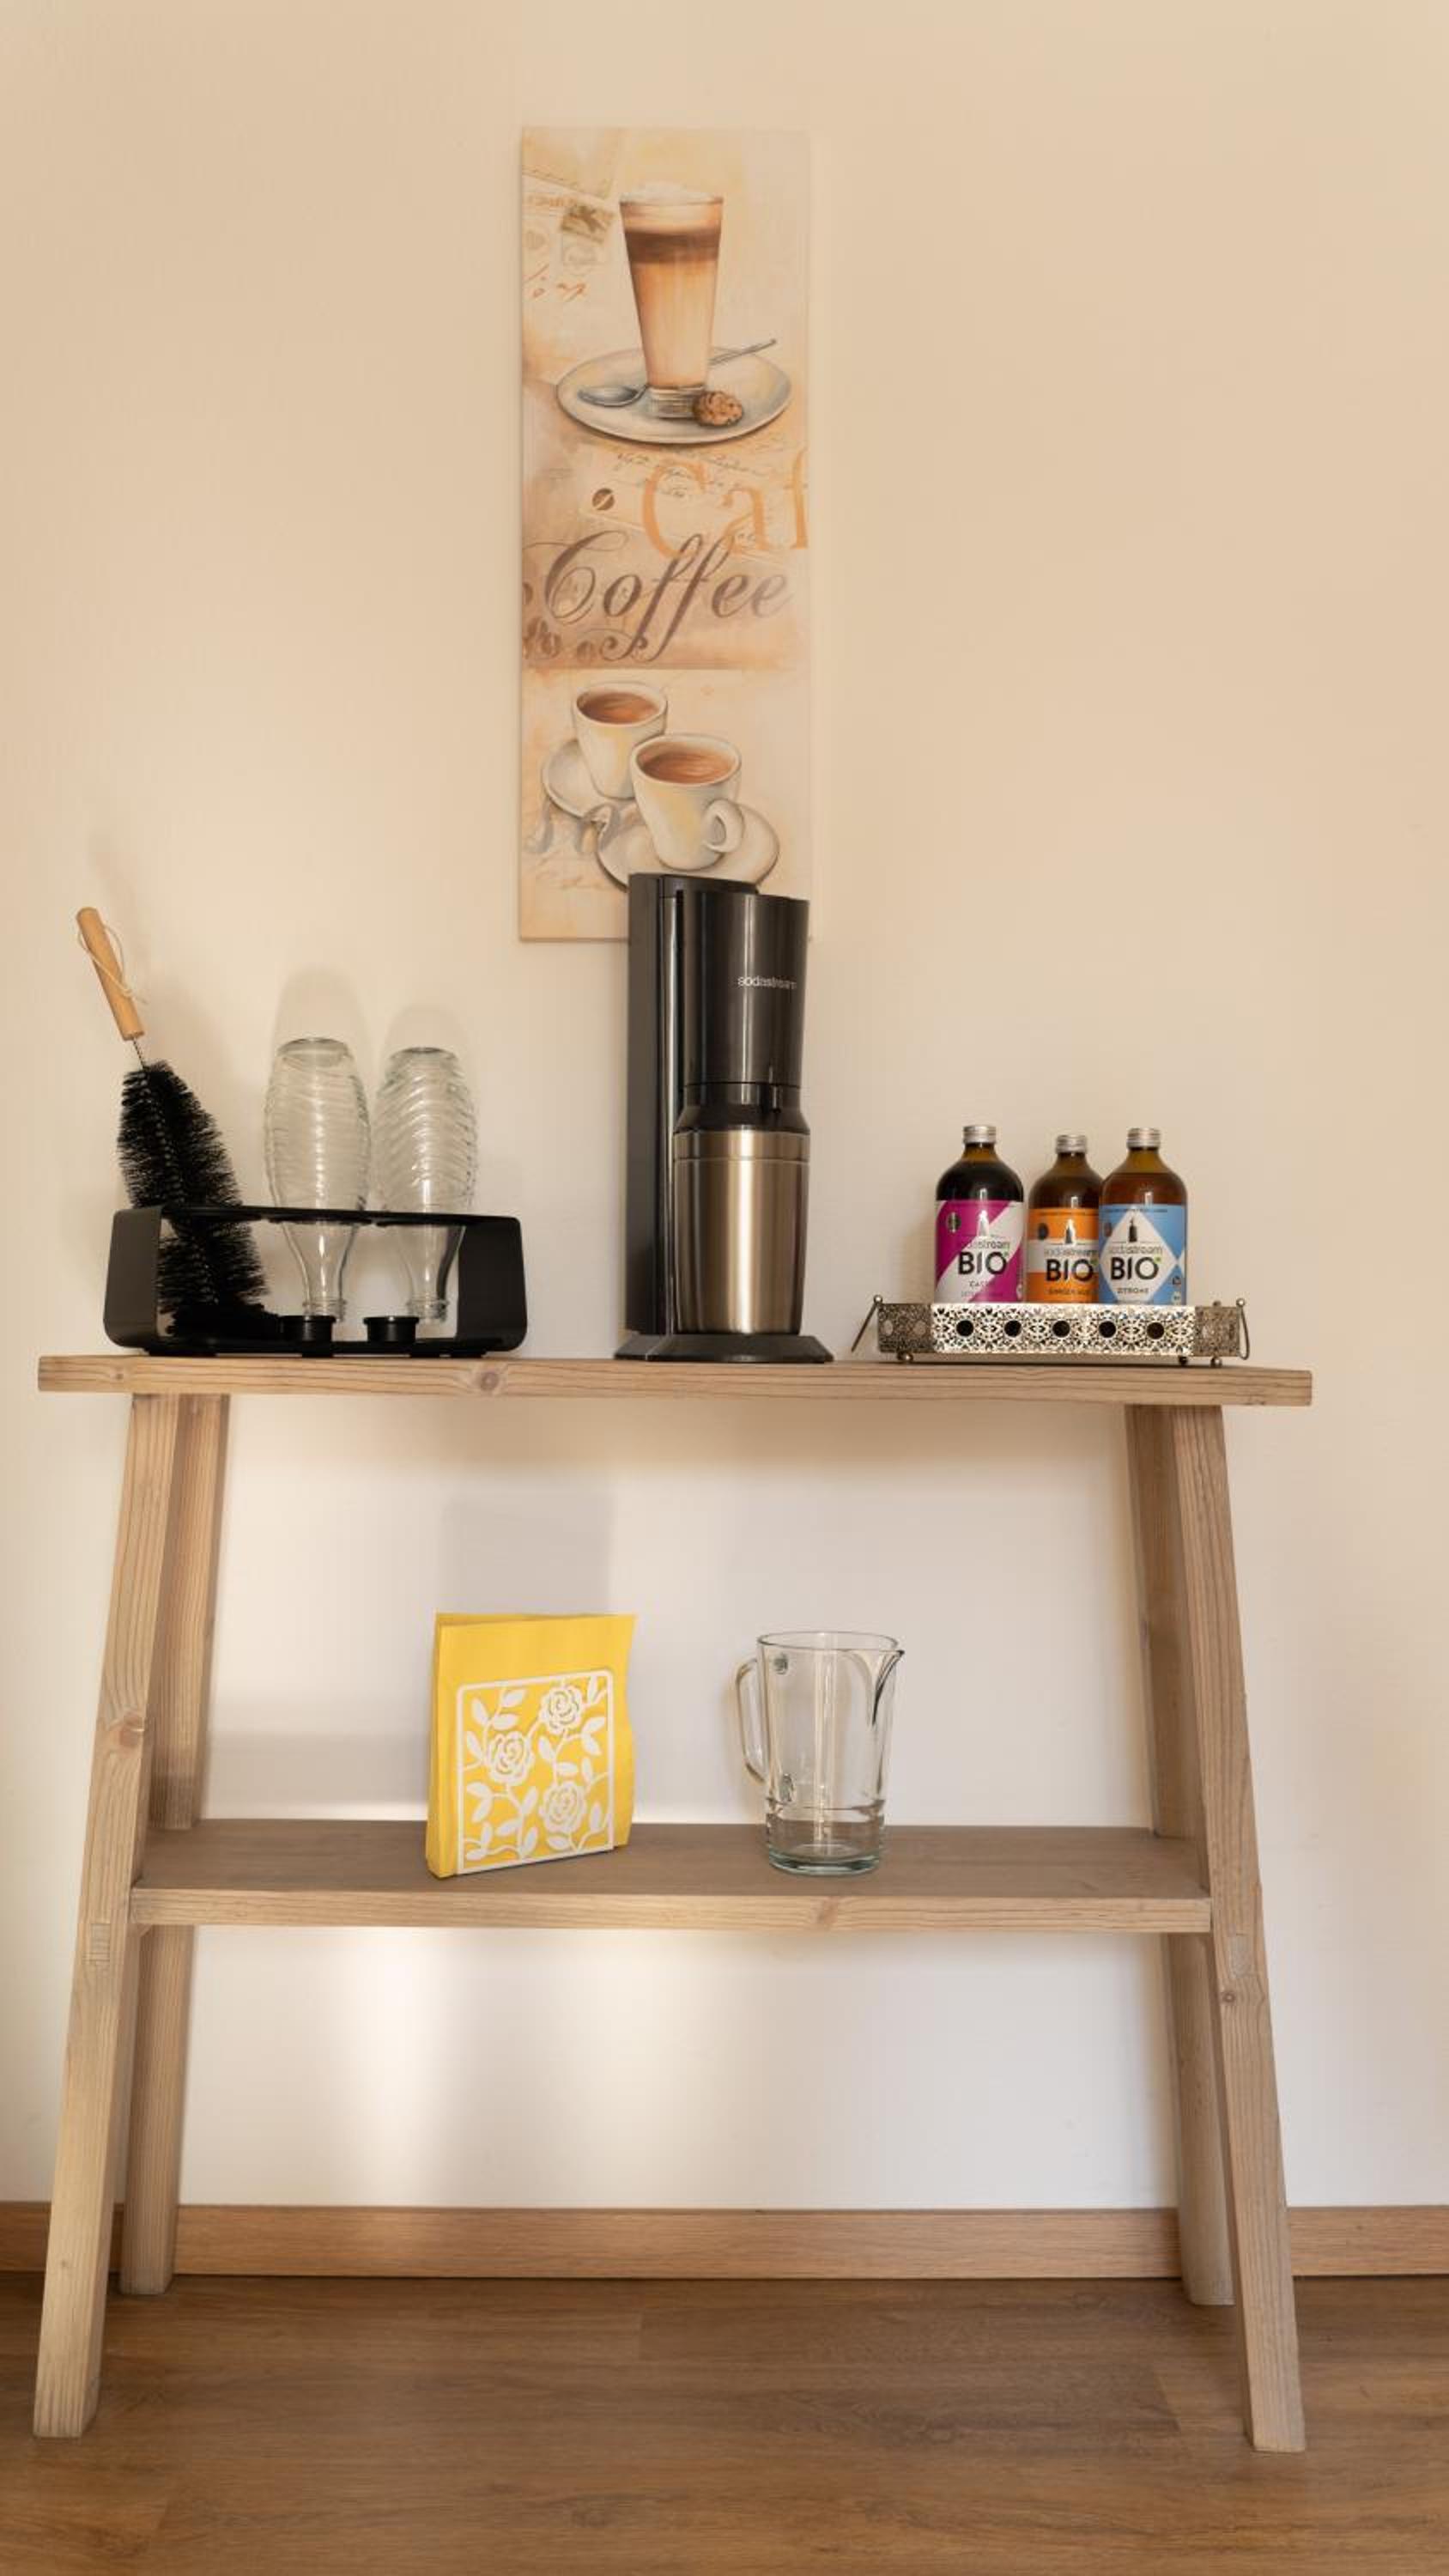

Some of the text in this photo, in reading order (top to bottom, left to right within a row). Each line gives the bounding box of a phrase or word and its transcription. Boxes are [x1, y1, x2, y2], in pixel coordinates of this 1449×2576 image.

[524, 530, 794, 661] Coffee
[737, 975, 797, 989] sodastream
[957, 1251, 1007, 1275] BIO
[1046, 1258, 1094, 1282] BIO
[1110, 1256, 1160, 1281] BIO
